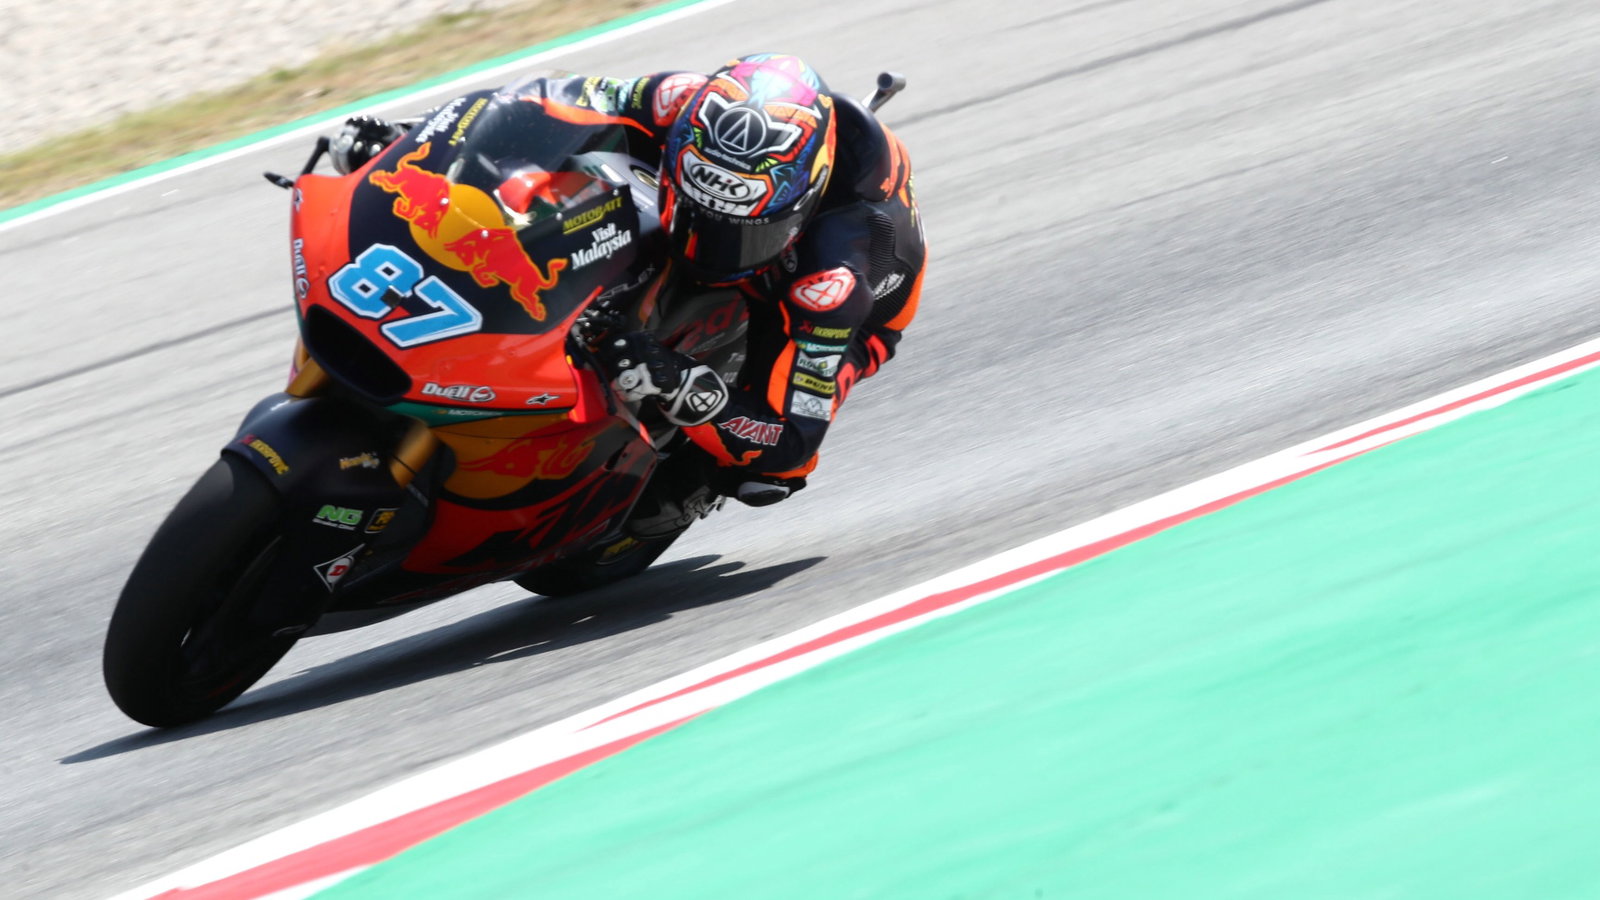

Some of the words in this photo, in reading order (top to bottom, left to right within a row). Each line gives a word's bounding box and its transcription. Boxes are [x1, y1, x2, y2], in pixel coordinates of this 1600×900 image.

[693, 167, 743, 195] NHK
[563, 196, 623, 234] MOTOBATT
[728, 216, 770, 226] WINGS
[591, 222, 616, 242] Visit
[571, 229, 632, 270] Malaysia
[328, 243, 482, 348] 87
[421, 382, 469, 399] Duell
[718, 416, 784, 446] AVANT
[317, 504, 363, 526] NG
